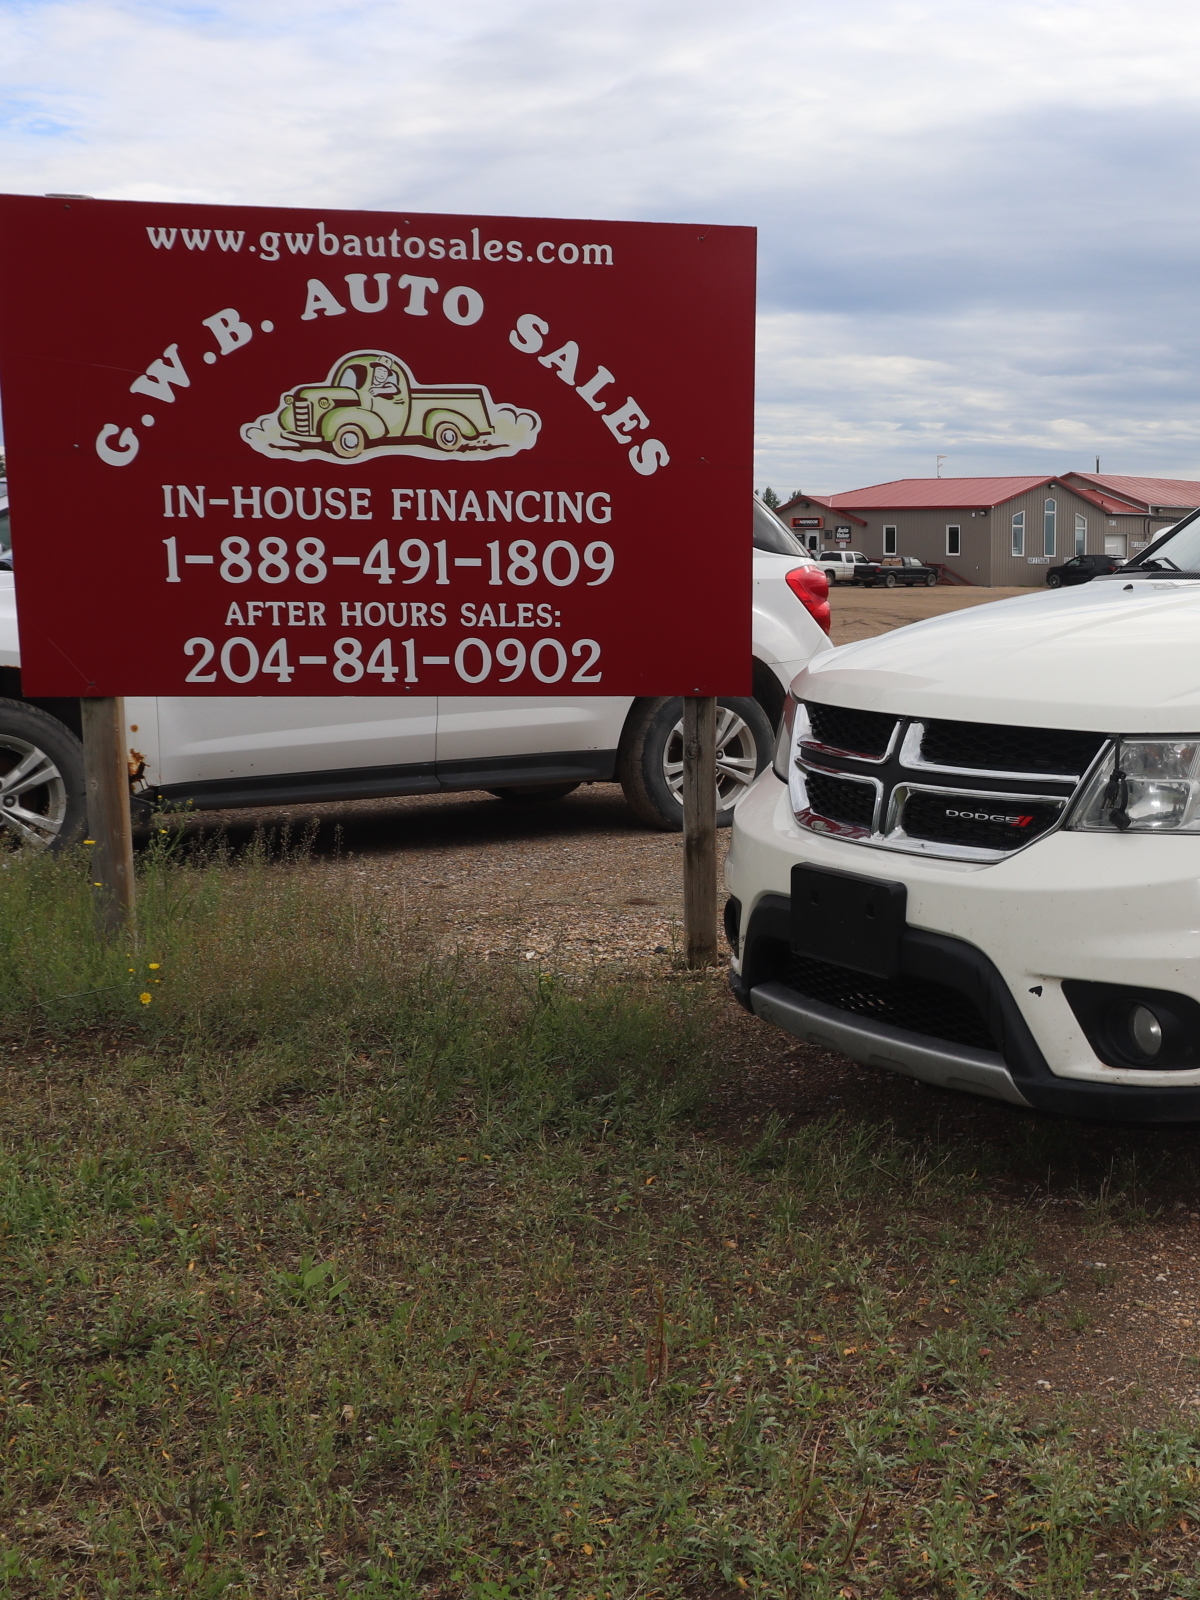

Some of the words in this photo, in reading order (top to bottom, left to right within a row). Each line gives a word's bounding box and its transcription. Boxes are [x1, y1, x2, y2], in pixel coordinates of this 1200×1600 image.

[145, 221, 614, 266] www.gwbautosales.com
[300, 272, 485, 327] AUTO
[508, 313, 671, 477] SALES
[161, 484, 373, 521] IN-HOUSE
[391, 488, 613, 524] FINANCING
[162, 535, 615, 588] 1-888-491-1809
[224, 601, 327, 628] AFTER
[339, 601, 447, 628] HOURS
[459, 601, 561, 628] SALES:
[183, 636, 604, 685] 204-841-0902
[945, 809, 1020, 824] DODGE
